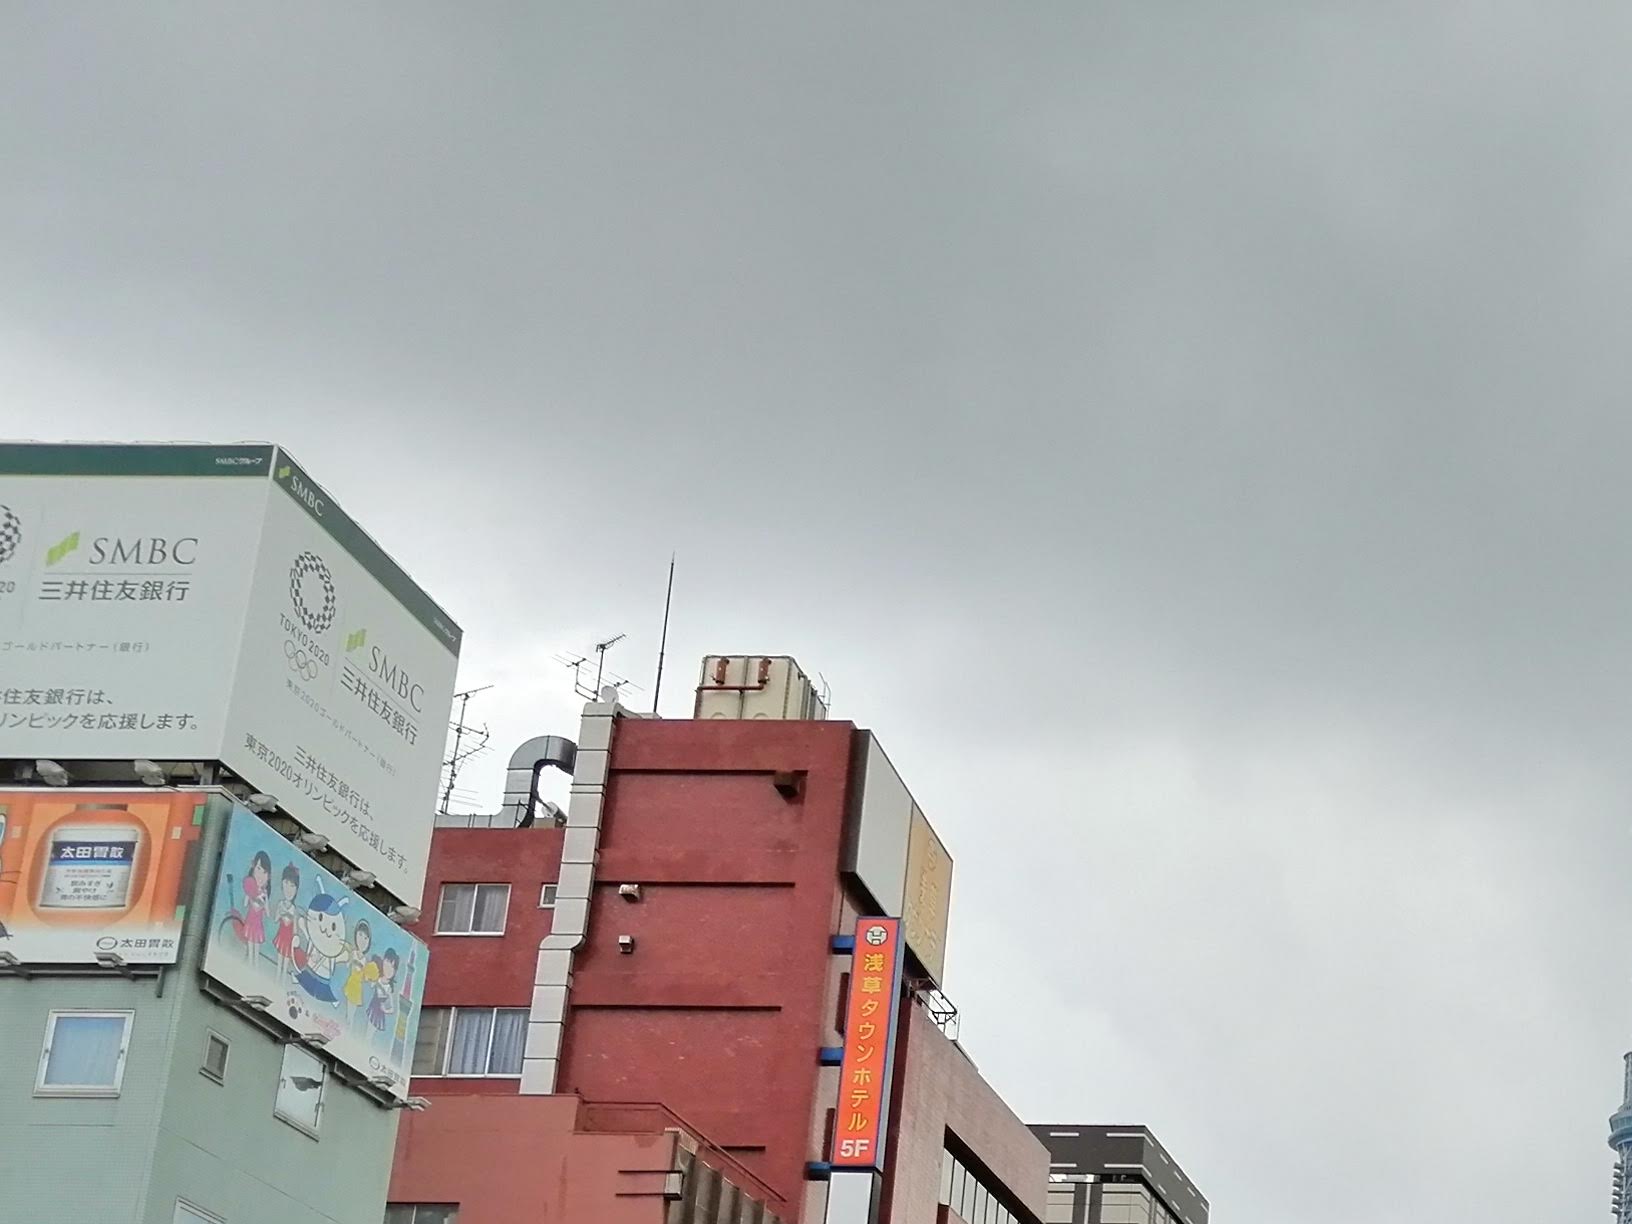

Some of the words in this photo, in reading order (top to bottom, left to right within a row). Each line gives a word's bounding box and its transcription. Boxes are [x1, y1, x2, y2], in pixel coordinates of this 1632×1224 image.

[291, 475, 324, 516] SMBC
[89, 537, 198, 565] SMBC
[38, 580, 190, 601] 三井住友銀行
[279, 612, 308, 648] TOKYO
[308, 640, 330, 666] 2020
[0, 688, 114, 705] 住友銀行は、
[368, 645, 424, 713] SMBC
[340, 664, 418, 746] 三井住友銀行
[243, 732, 409, 875] 東京2020オリンピックを応援します。
[293, 745, 374, 821] 三井住友銀行は、
[60, 845, 125, 859] 太田胃散
[120, 938, 175, 949] 太田胃散
[847, 952, 886, 1132] 浅草タウンホテル
[840, 1138, 870, 1158] 5F
